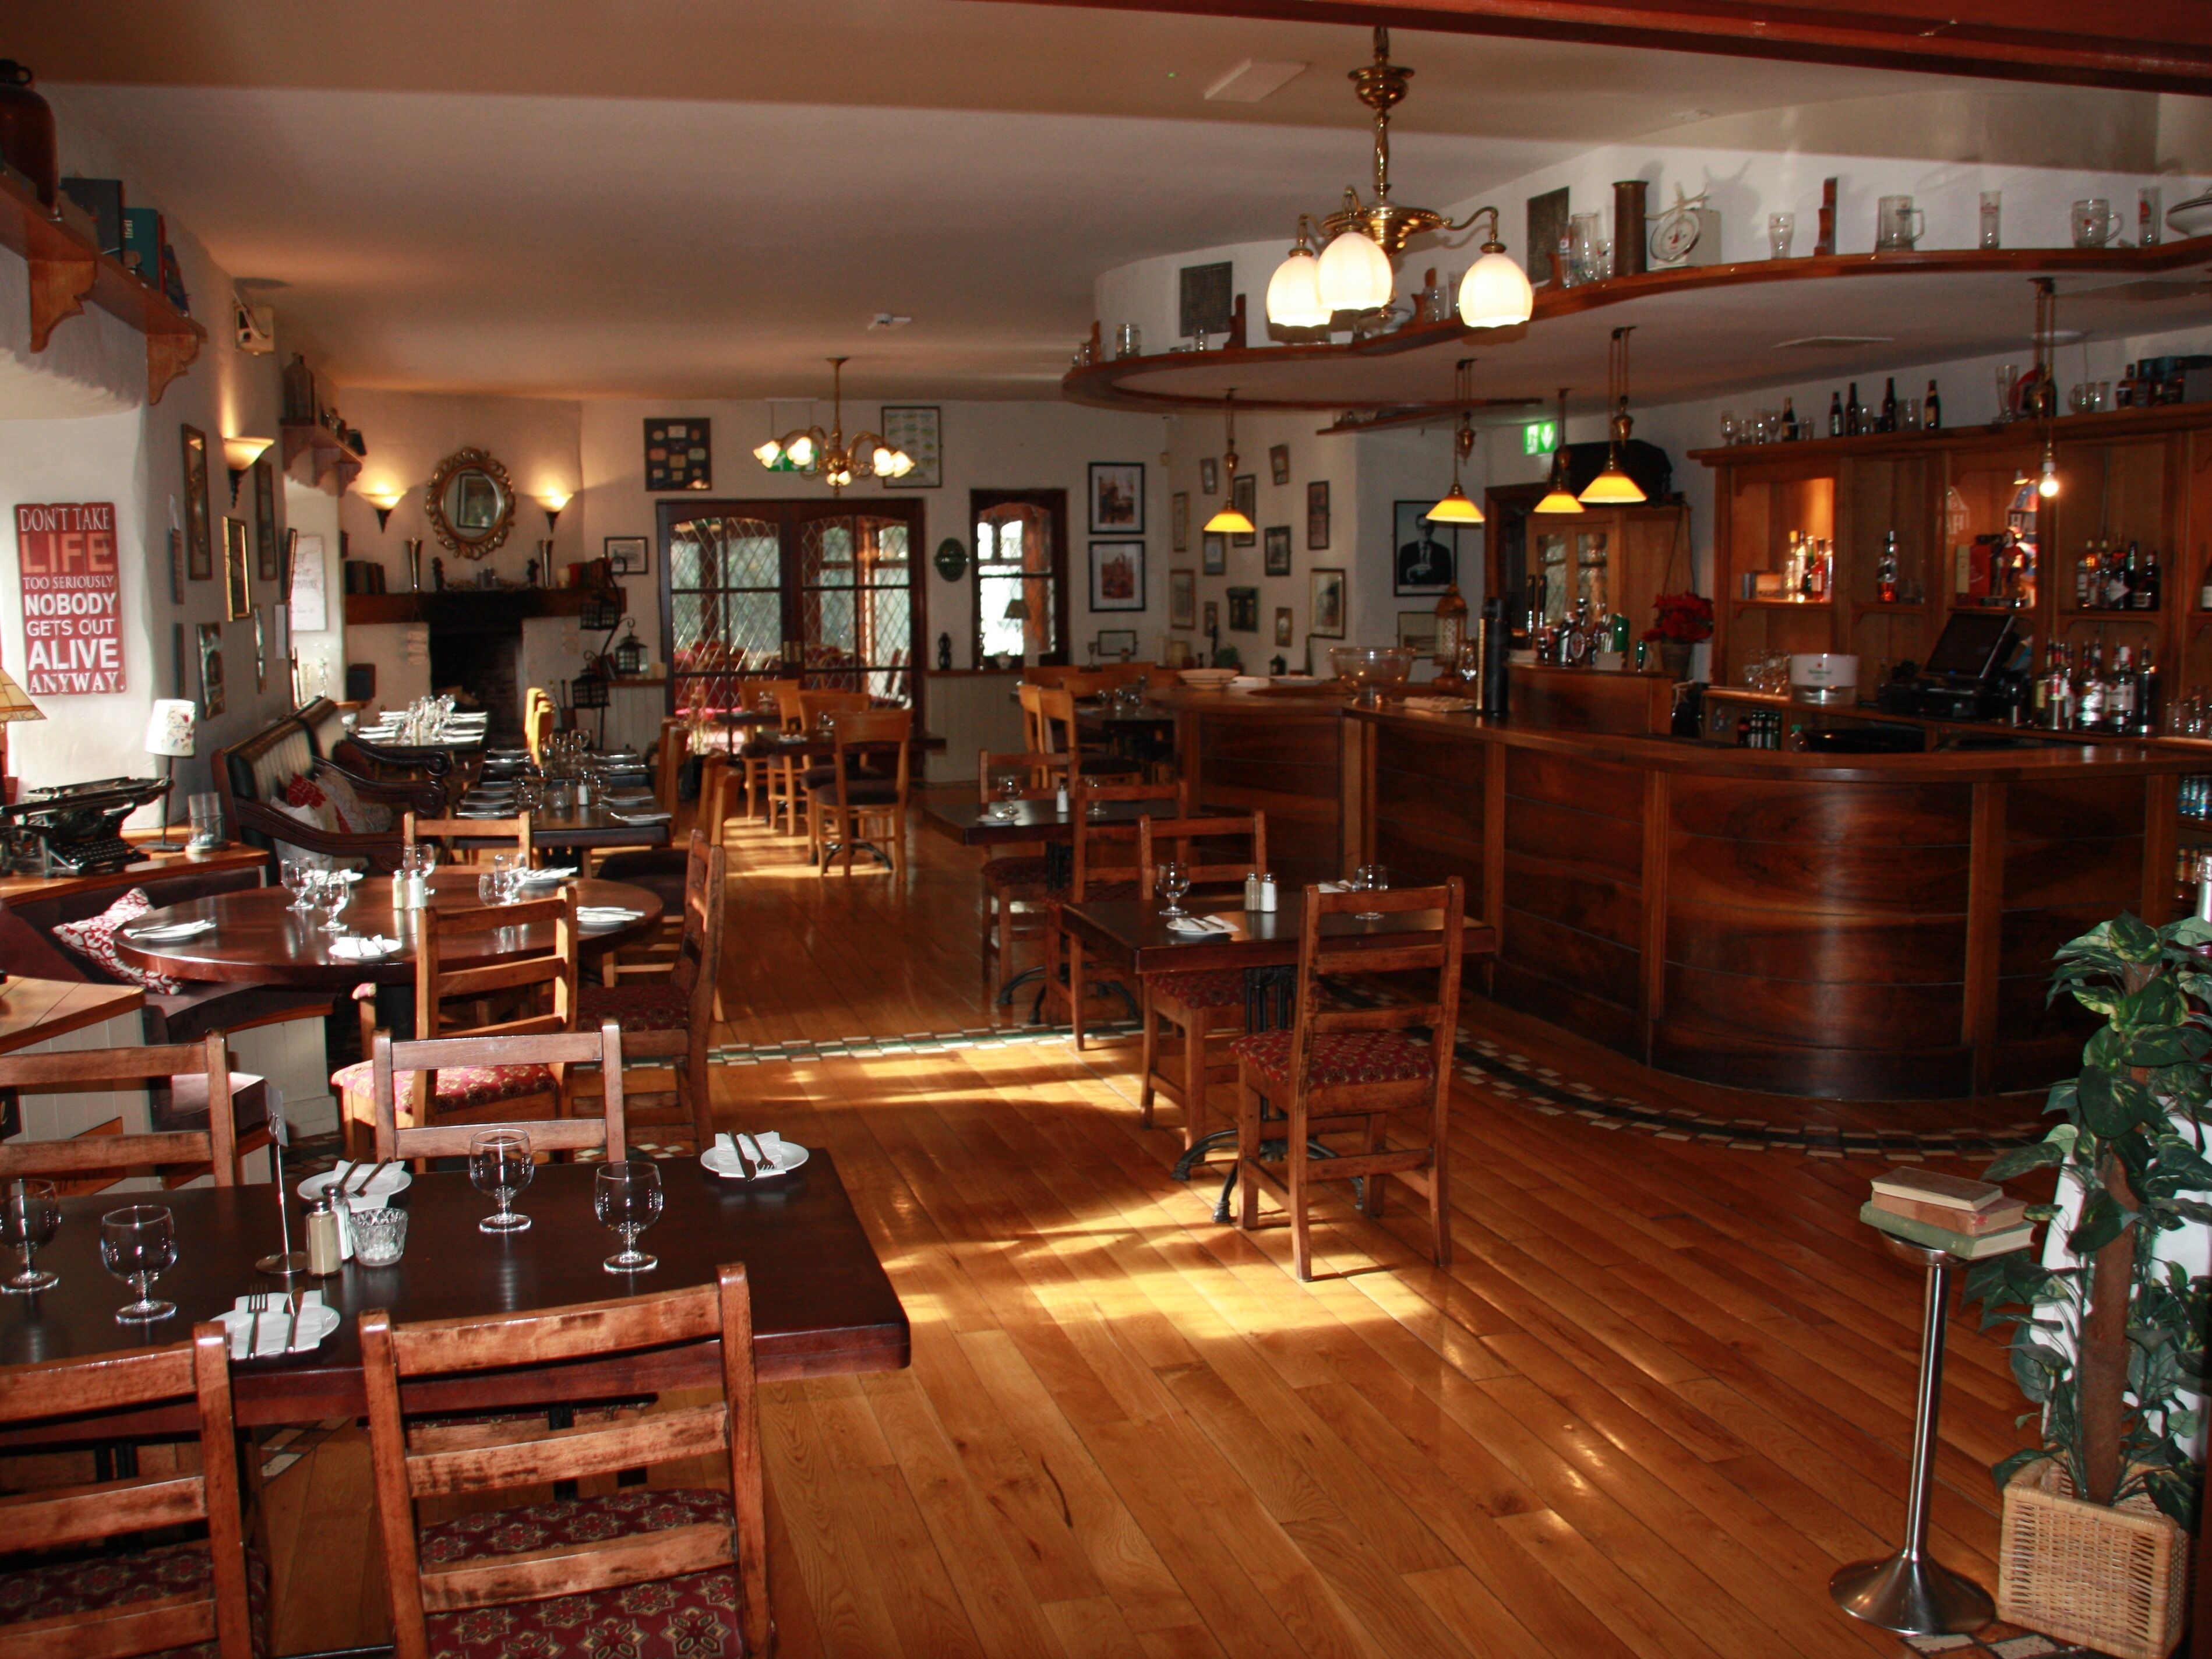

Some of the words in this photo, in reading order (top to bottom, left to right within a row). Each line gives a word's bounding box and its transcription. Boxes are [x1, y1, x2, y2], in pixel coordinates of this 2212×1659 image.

[19, 507, 69, 532] DON'T
[72, 507, 111, 531] TAKE
[20, 532, 114, 574] LIFE
[23, 577, 50, 590] TOO
[52, 574, 114, 590] SERIOUSLY
[24, 592, 117, 617] NOBODY
[26, 619, 73, 637] GETS
[79, 619, 115, 636] OUT
[28, 638, 119, 671] ALIVE
